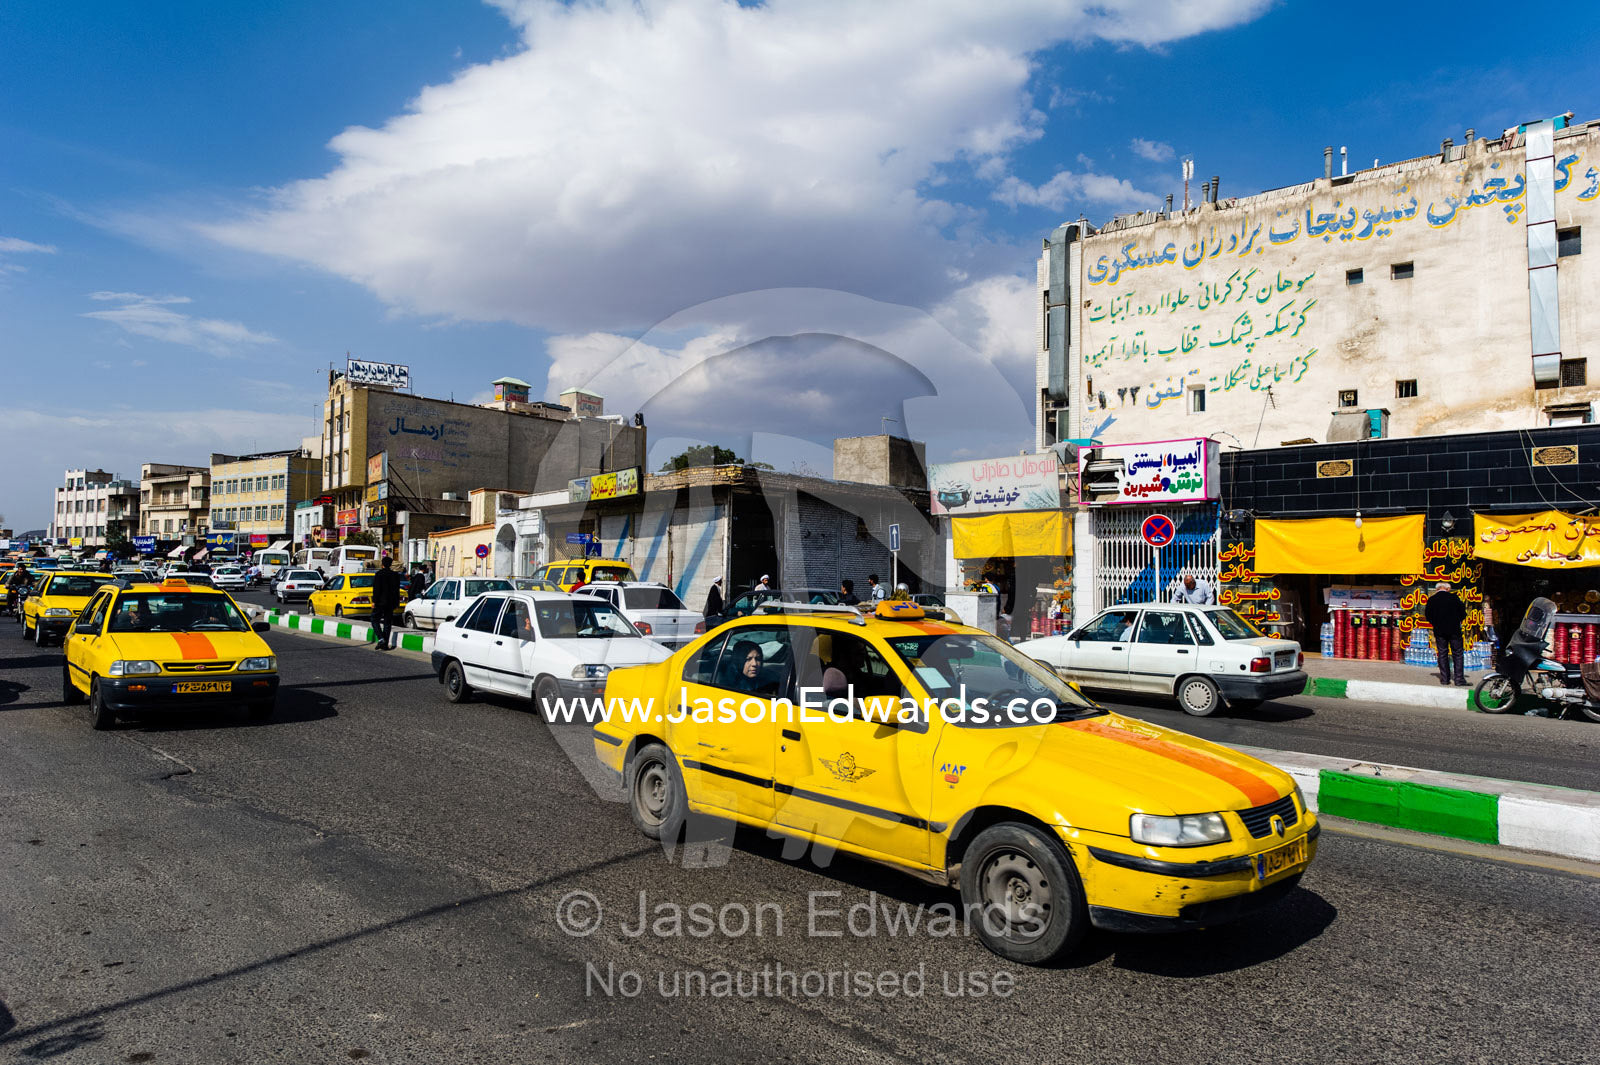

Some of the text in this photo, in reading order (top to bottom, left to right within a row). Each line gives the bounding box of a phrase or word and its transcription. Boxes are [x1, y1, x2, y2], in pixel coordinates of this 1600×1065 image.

[1182, 215, 1264, 270] برادران
[1087, 239, 1179, 286] عسکری
[1198, 268, 1241, 311] کرمانی
[1235, 266, 1259, 303] گز
[1256, 269, 1316, 305] سوهان
[1089, 289, 1137, 325] آبنبات
[1290, 298, 1318, 338] گز
[1208, 310, 1256, 354] پشمک
[1084, 334, 1120, 369] آبمیوه
[388, 416, 444, 440] اردهال
[1014, 458, 1057, 478] سوهان
[1127, 452, 1163, 476] بستنی
[1123, 473, 1163, 498] شیرین
[1169, 471, 1203, 494] ترش
[973, 486, 1021, 507] خوشبخت
[1480, 515, 1557, 542] مخصوص
[1516, 540, 1584, 566] مجلسی
[889, 601, 919, 612] تاکسی
[1217, 587, 1281, 605] دسری
